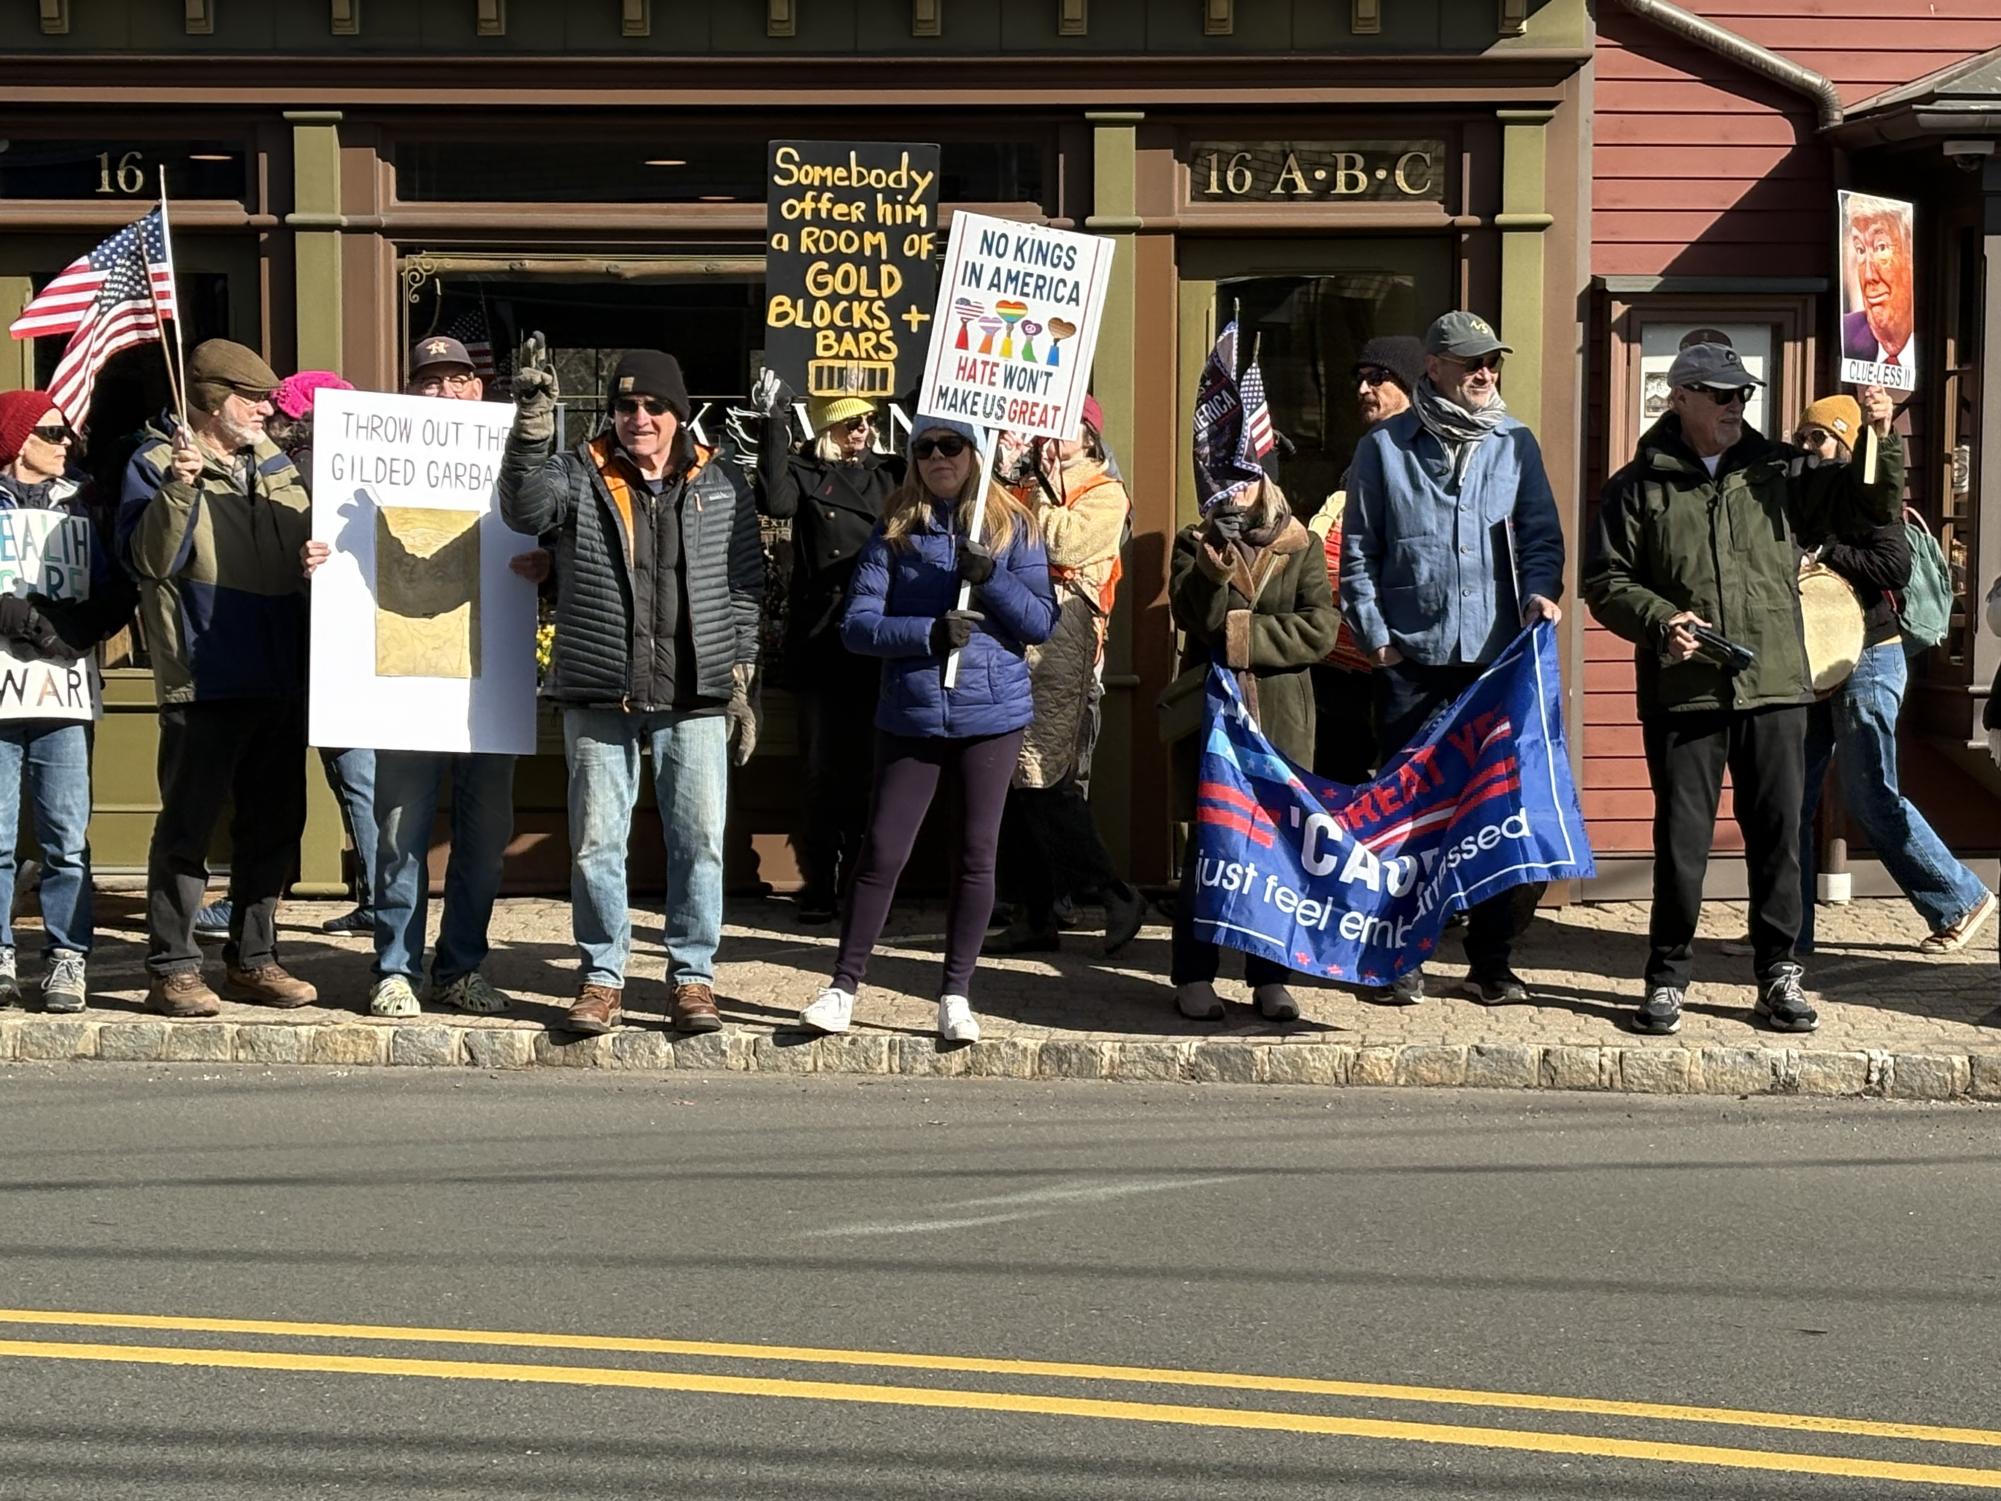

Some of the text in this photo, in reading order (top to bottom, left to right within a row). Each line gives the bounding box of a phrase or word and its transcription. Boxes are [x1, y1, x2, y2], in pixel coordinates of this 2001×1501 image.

[96, 151, 144, 193] 16
[773, 147, 934, 204] Somebody
[1204, 152, 1252, 194] 16
[771, 227, 937, 260] a ROOM OF
[979, 229, 1078, 272] NO KINGS
[805, 261, 903, 299] GOLD
[961, 260, 1080, 307] IN AMERICA
[767, 295, 931, 333] BLOCKS +
[816, 329, 899, 360] BARS
[955, 356, 1054, 396] HATE WON'T
[935, 385, 1061, 430] MAKE US GREAT
[342, 412, 413, 444] THROW
[422, 419, 464, 447] OUT
[331, 453, 494, 491] GILDED GARBA
[0, 513, 88, 568] EALTH
[0, 564, 84, 602] CRE
[1335, 745, 1444, 832] REAT
[1195, 849, 1258, 895] just
[1263, 873, 1334, 931] feel
